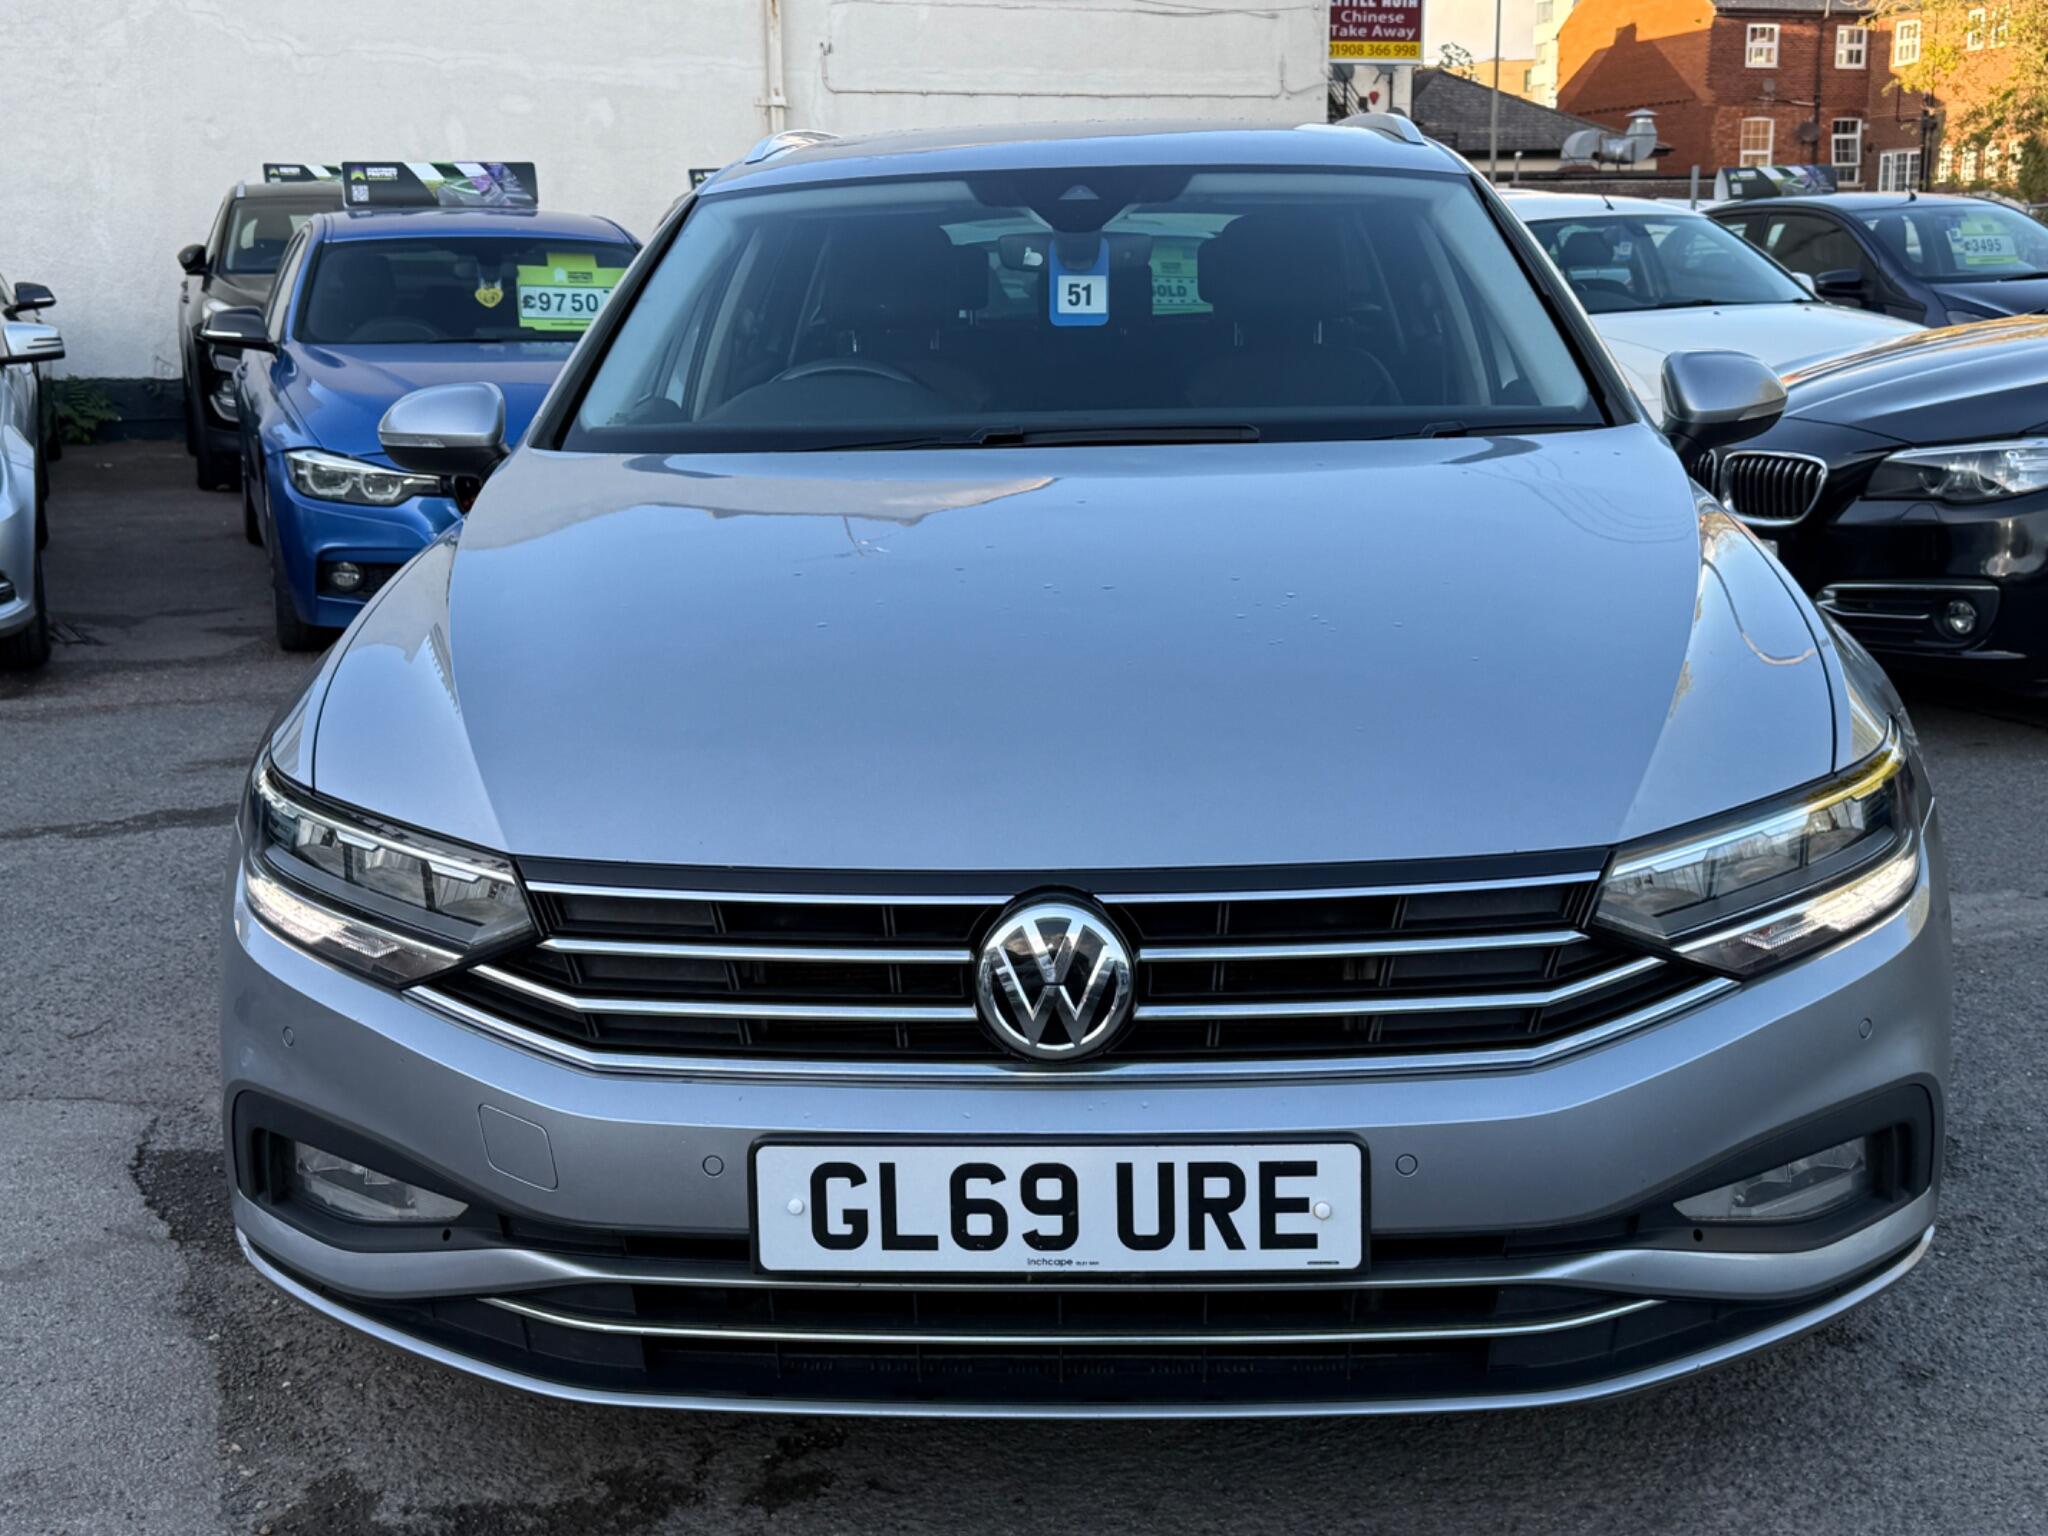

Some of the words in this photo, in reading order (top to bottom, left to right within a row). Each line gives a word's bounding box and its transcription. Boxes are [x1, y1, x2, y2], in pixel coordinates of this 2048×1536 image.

[1341, 10, 1405, 23] Chinese
[1331, 24, 1367, 37] Take
[1372, 25, 1416, 40] Away
[1394, 45, 1417, 56] 998
[522, 292, 599, 312] £9750
[1067, 284, 1091, 306] 51
[810, 1162, 1079, 1251] GL69
[1115, 1161, 1319, 1250] URE
